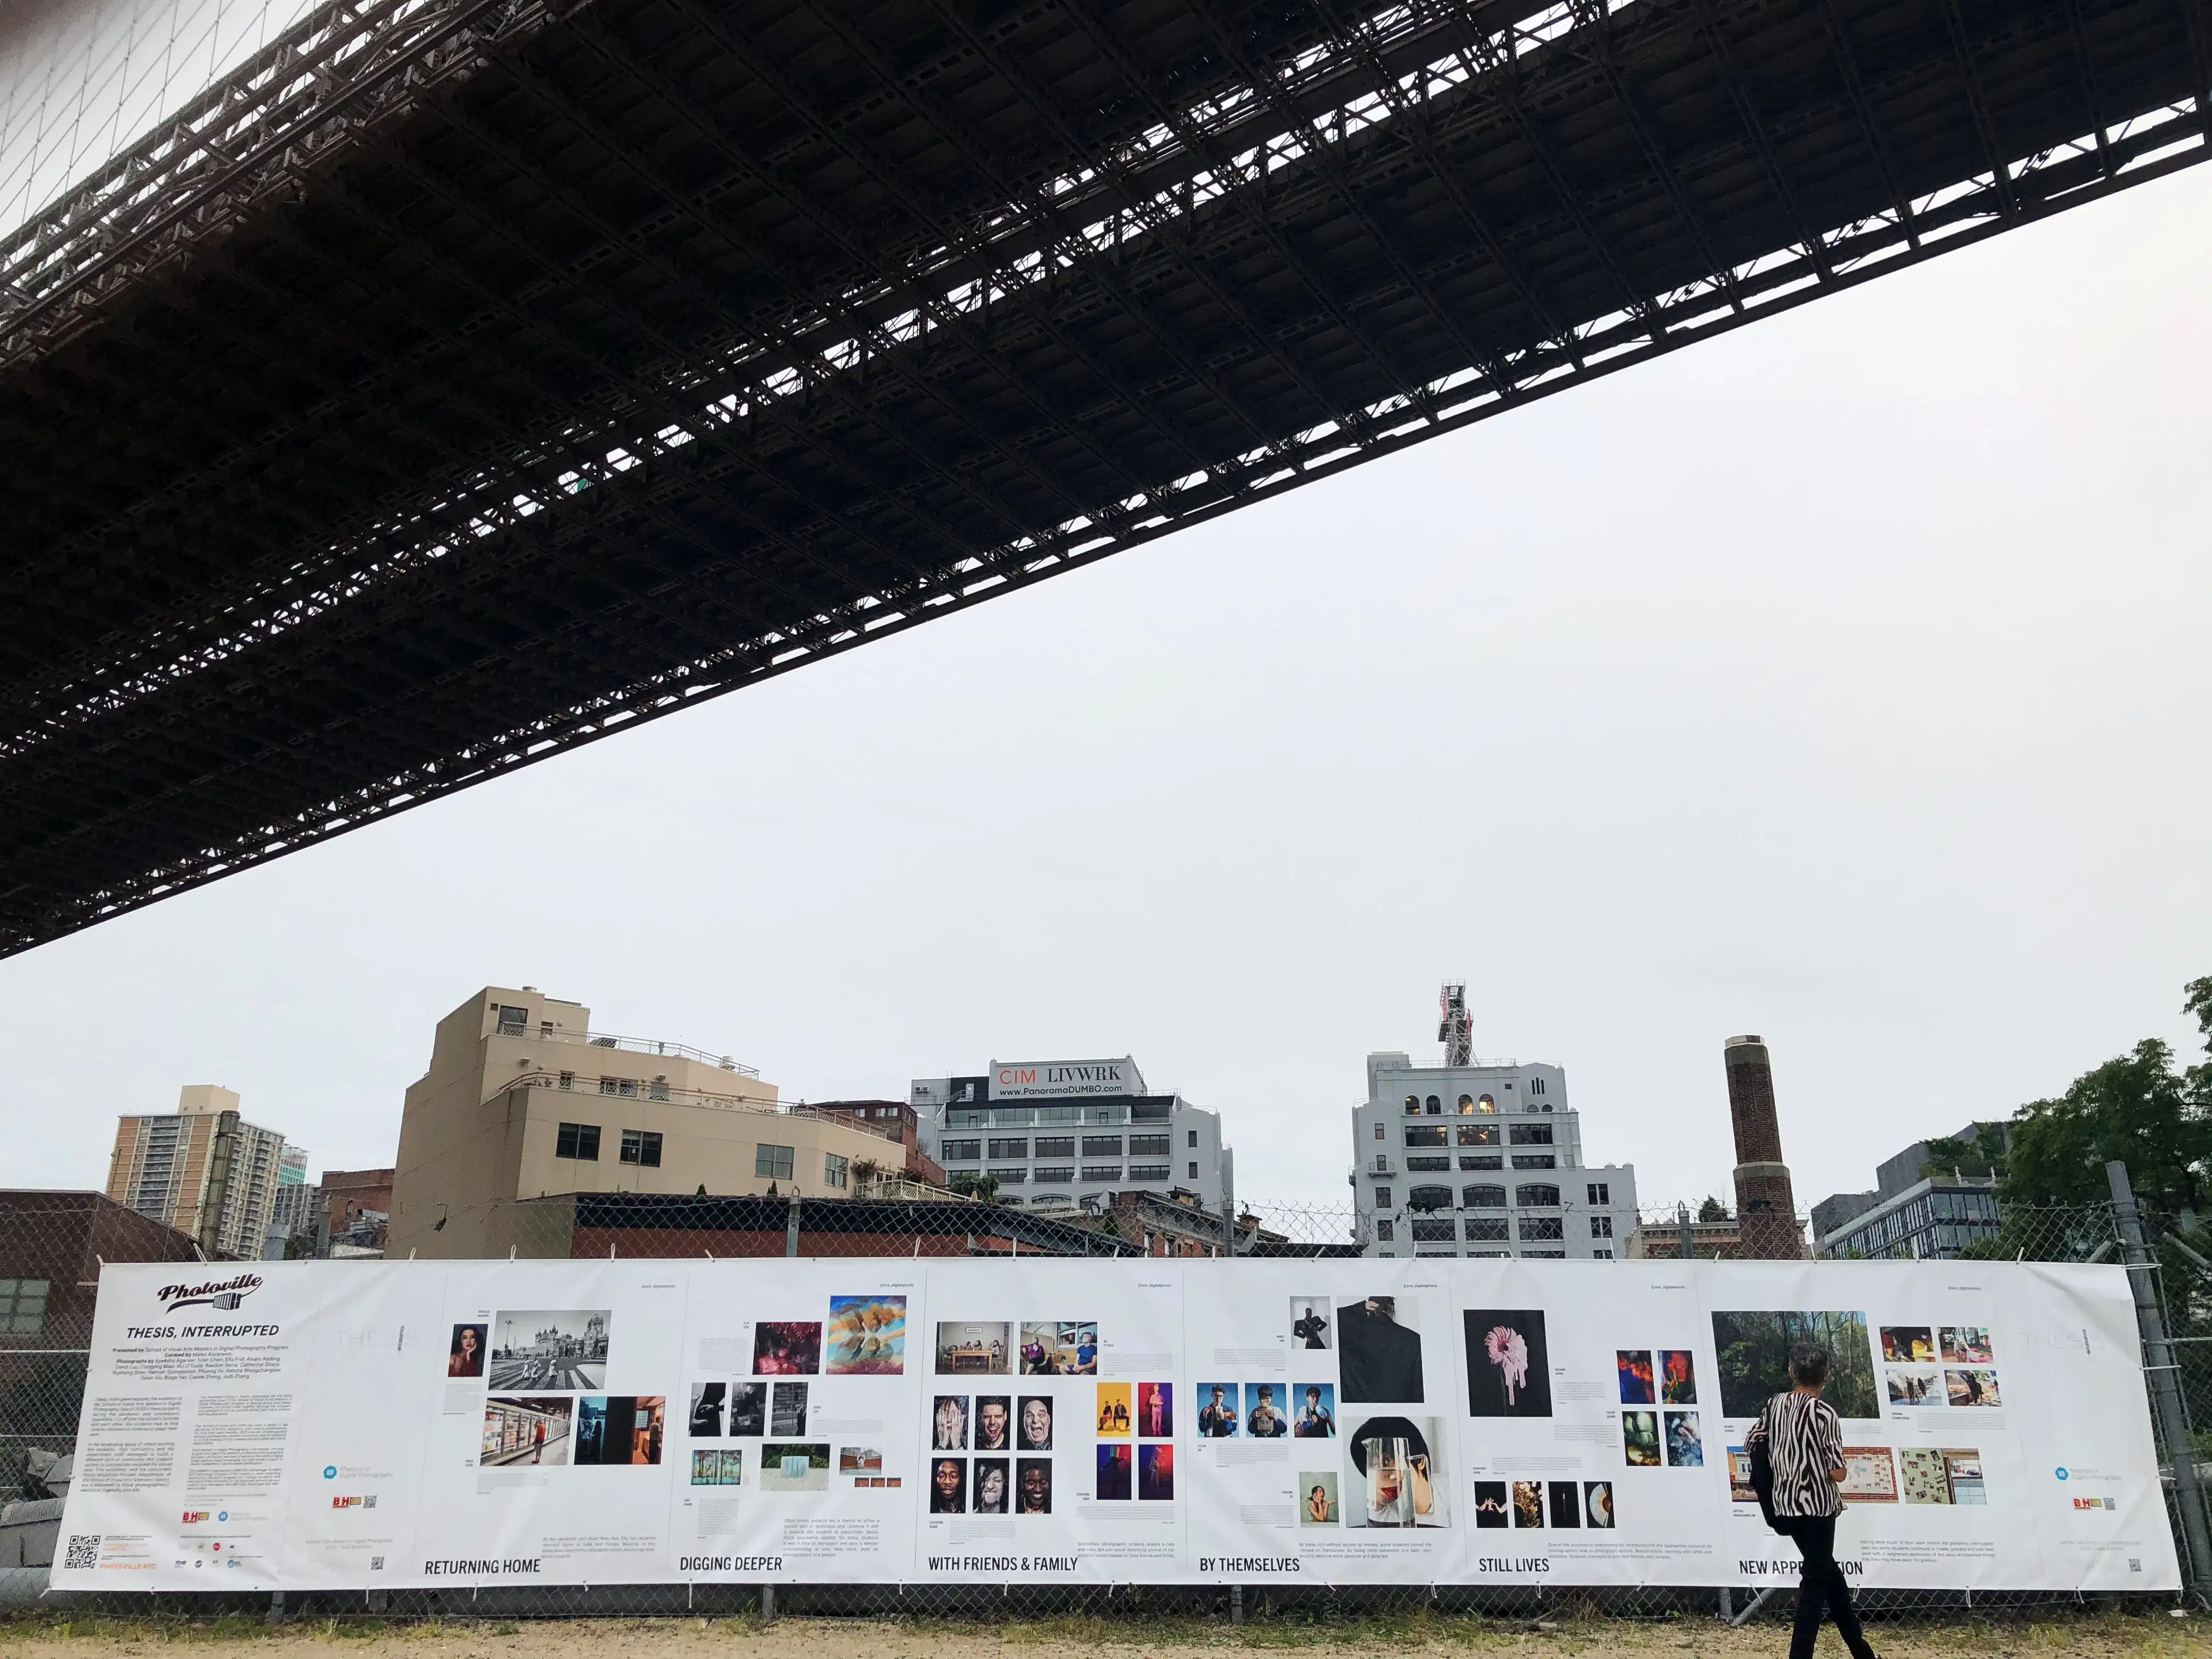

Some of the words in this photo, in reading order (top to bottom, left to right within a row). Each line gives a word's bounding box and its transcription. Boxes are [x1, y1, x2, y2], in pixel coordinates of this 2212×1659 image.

[999, 1069, 1036, 1085] CIM
[1047, 1066, 1121, 1082] LIVWRK
[1000, 1085, 1122, 1096] www.PanoramaDUMBO.com
[156, 1273, 262, 1302] Photoville
[127, 1327, 176, 1340] THESIS,
[181, 1325, 279, 1338] INTERRUPTED
[425, 1560, 499, 1575] RETURNING
[503, 1559, 541, 1573] HOME
[680, 1556, 731, 1571] DIGGING
[735, 1557, 782, 1571] DEEPER
[928, 1557, 960, 1571] WITH
[964, 1557, 1017, 1571] FRIENDS
[1021, 1558, 1030, 1571] &
[1034, 1557, 1078, 1571] FAMILY
[1200, 1558, 1216, 1571] BY
[1219, 1558, 1300, 1571] THEMSELVES
[1479, 1558, 1513, 1572] STILL
[1516, 1558, 1549, 1572] LIVES
[1739, 1560, 1768, 1575] NEW
